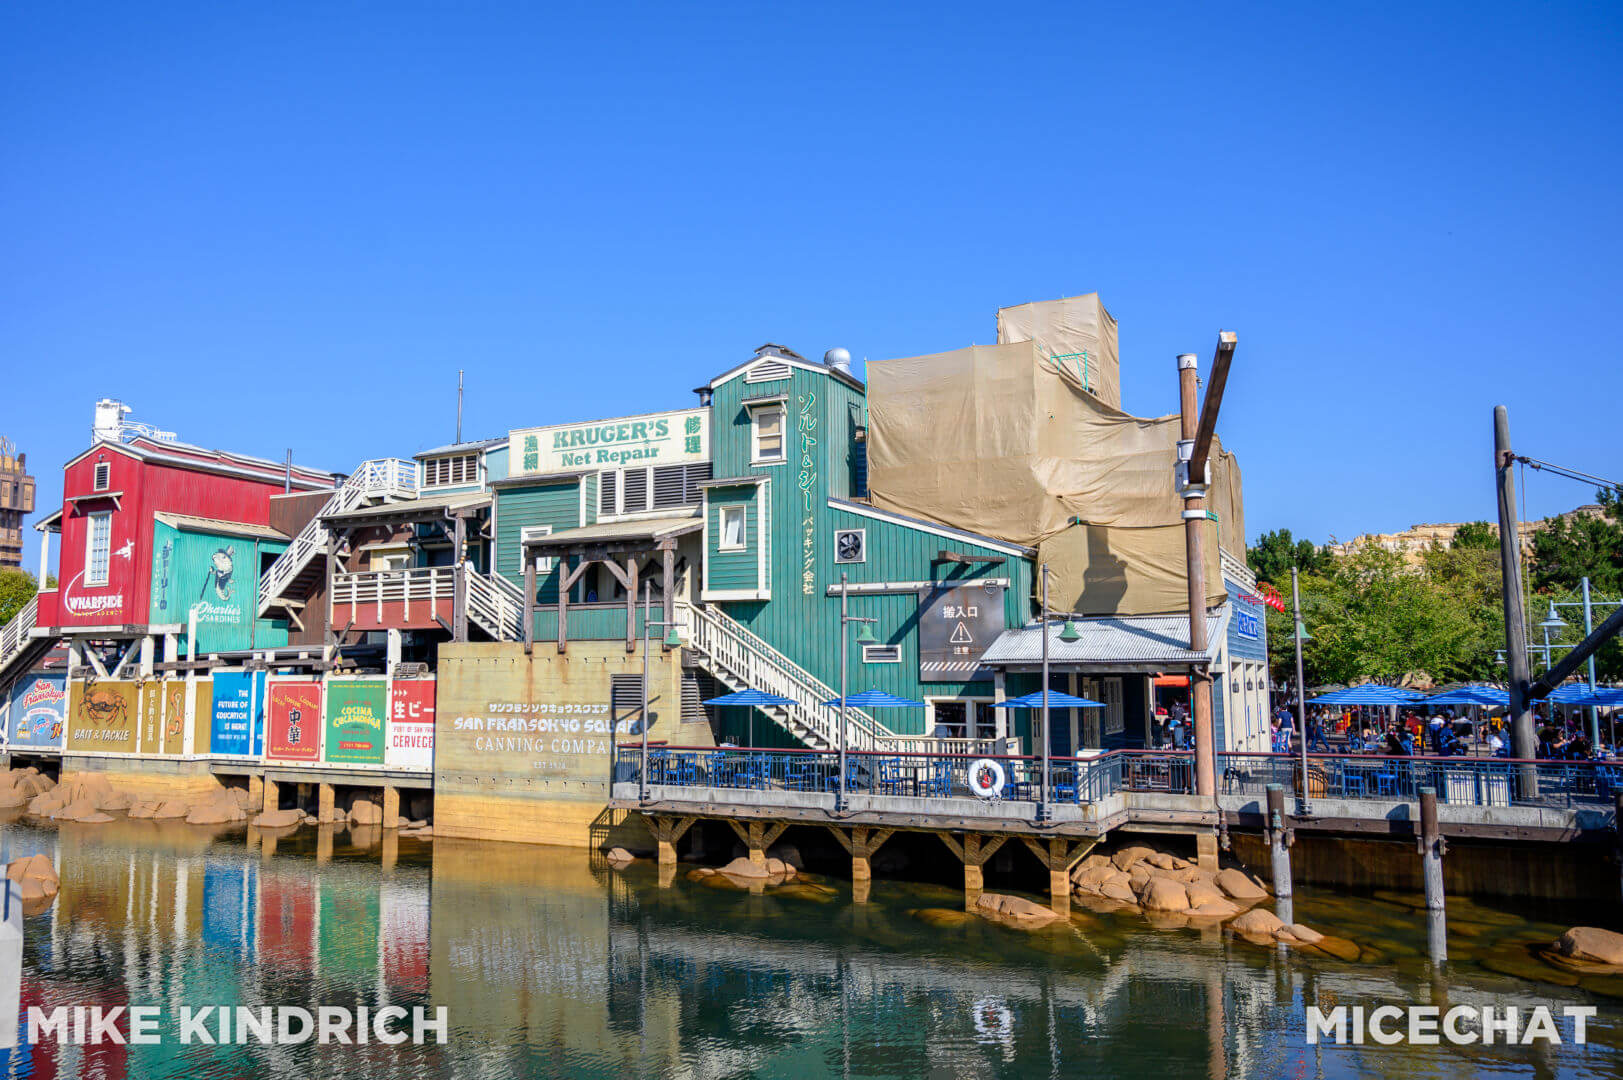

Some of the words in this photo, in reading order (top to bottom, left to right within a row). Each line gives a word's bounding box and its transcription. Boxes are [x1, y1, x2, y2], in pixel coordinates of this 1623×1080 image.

[553, 419, 669, 449] KRUGER'S
[684, 416, 702, 454] 修理
[561, 452, 592, 467] Net
[596, 447, 660, 465] Repair
[69, 595, 123, 610] WHARFSIDE
[217, 700, 239, 709] FUTURE
[239, 701, 249, 709] OF
[454, 717, 484, 731] SAN
[487, 718, 580, 732] FRANSOKYO
[74, 729, 93, 741] BAIT
[93, 731, 100, 741] &
[101, 730, 130, 742] TACKLE
[475, 736, 545, 753] CANNING
